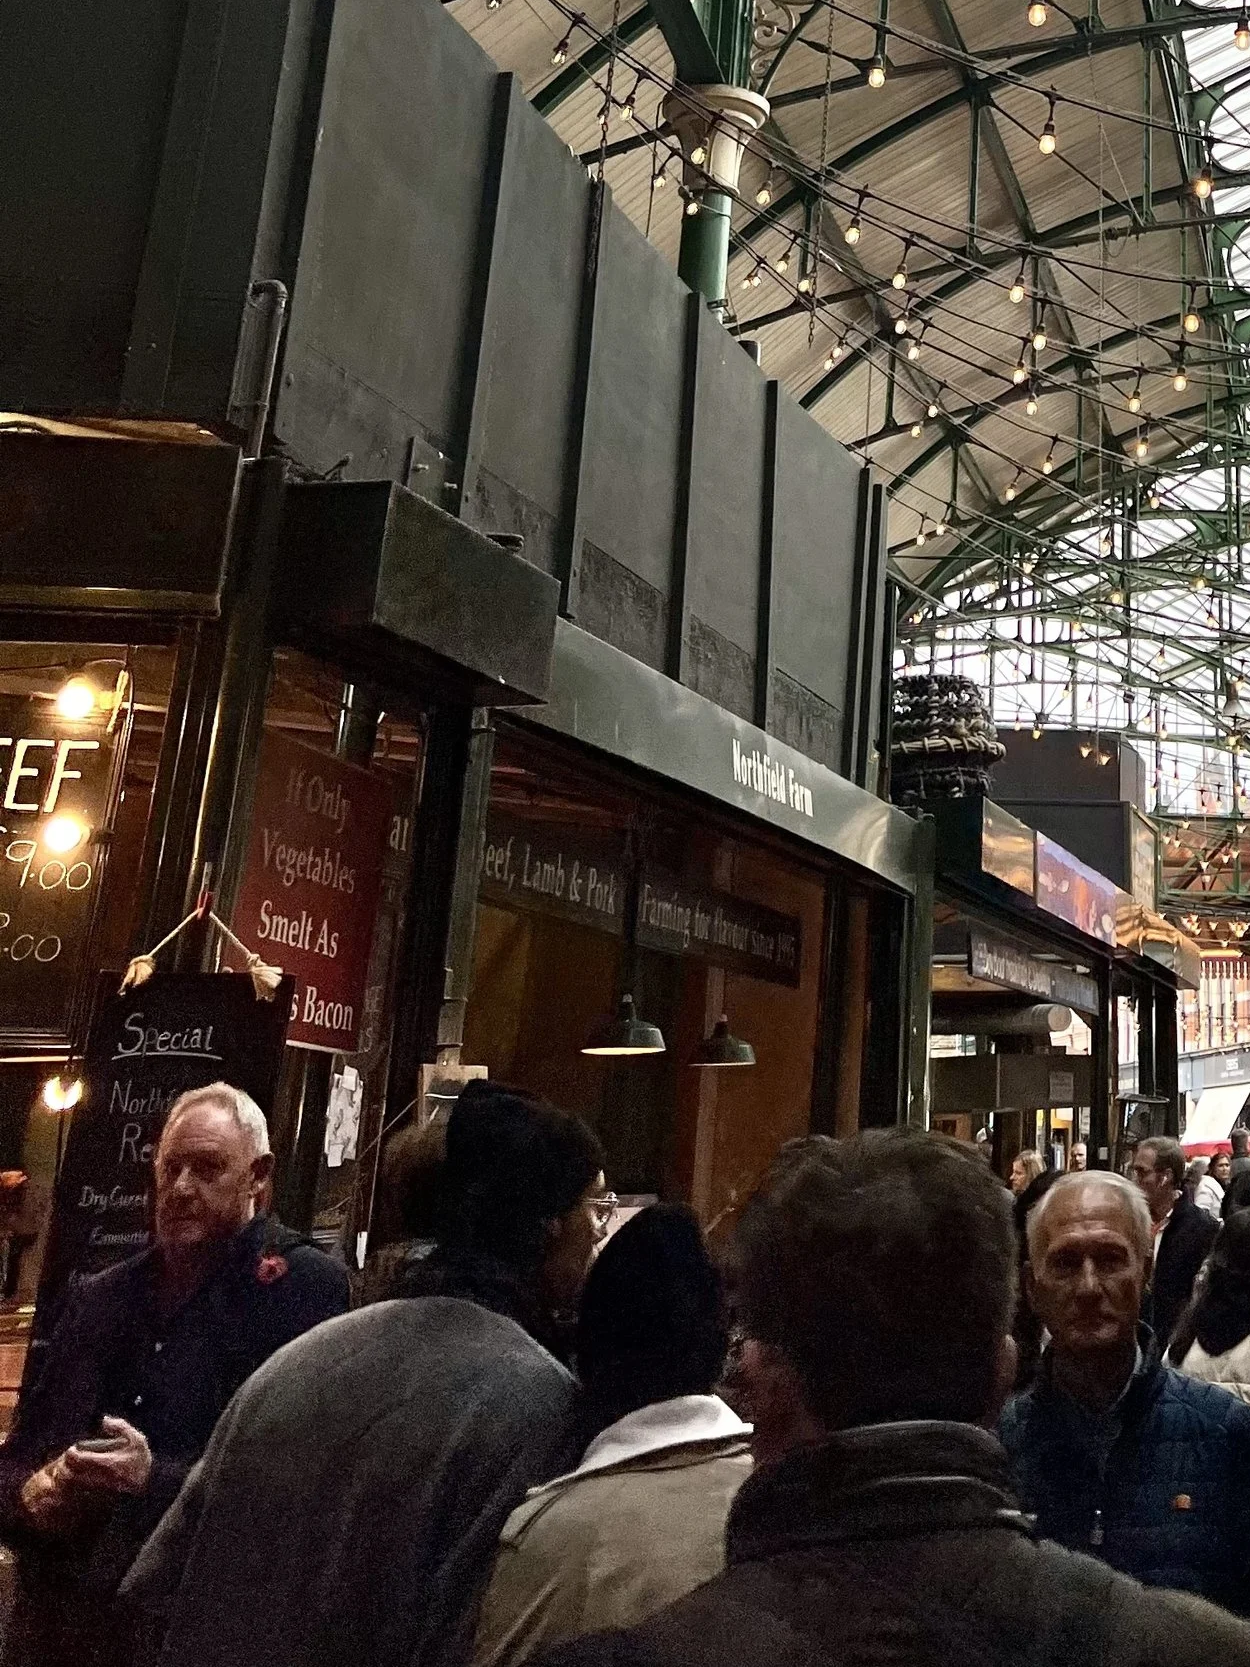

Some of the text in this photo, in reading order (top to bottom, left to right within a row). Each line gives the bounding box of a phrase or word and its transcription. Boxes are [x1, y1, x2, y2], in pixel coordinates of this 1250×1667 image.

[307, 775, 351, 834] Only
[732, 738, 814, 818] Northfield Farm
[260, 827, 356, 894] Vegetables
[522, 843, 565, 897] Lamb
[570, 859, 583, 903] &
[586, 867, 617, 915] Pork
[257, 899, 339, 959] Smelt As
[117, 1012, 215, 1057] Special
[303, 985, 354, 1032] Bacon
